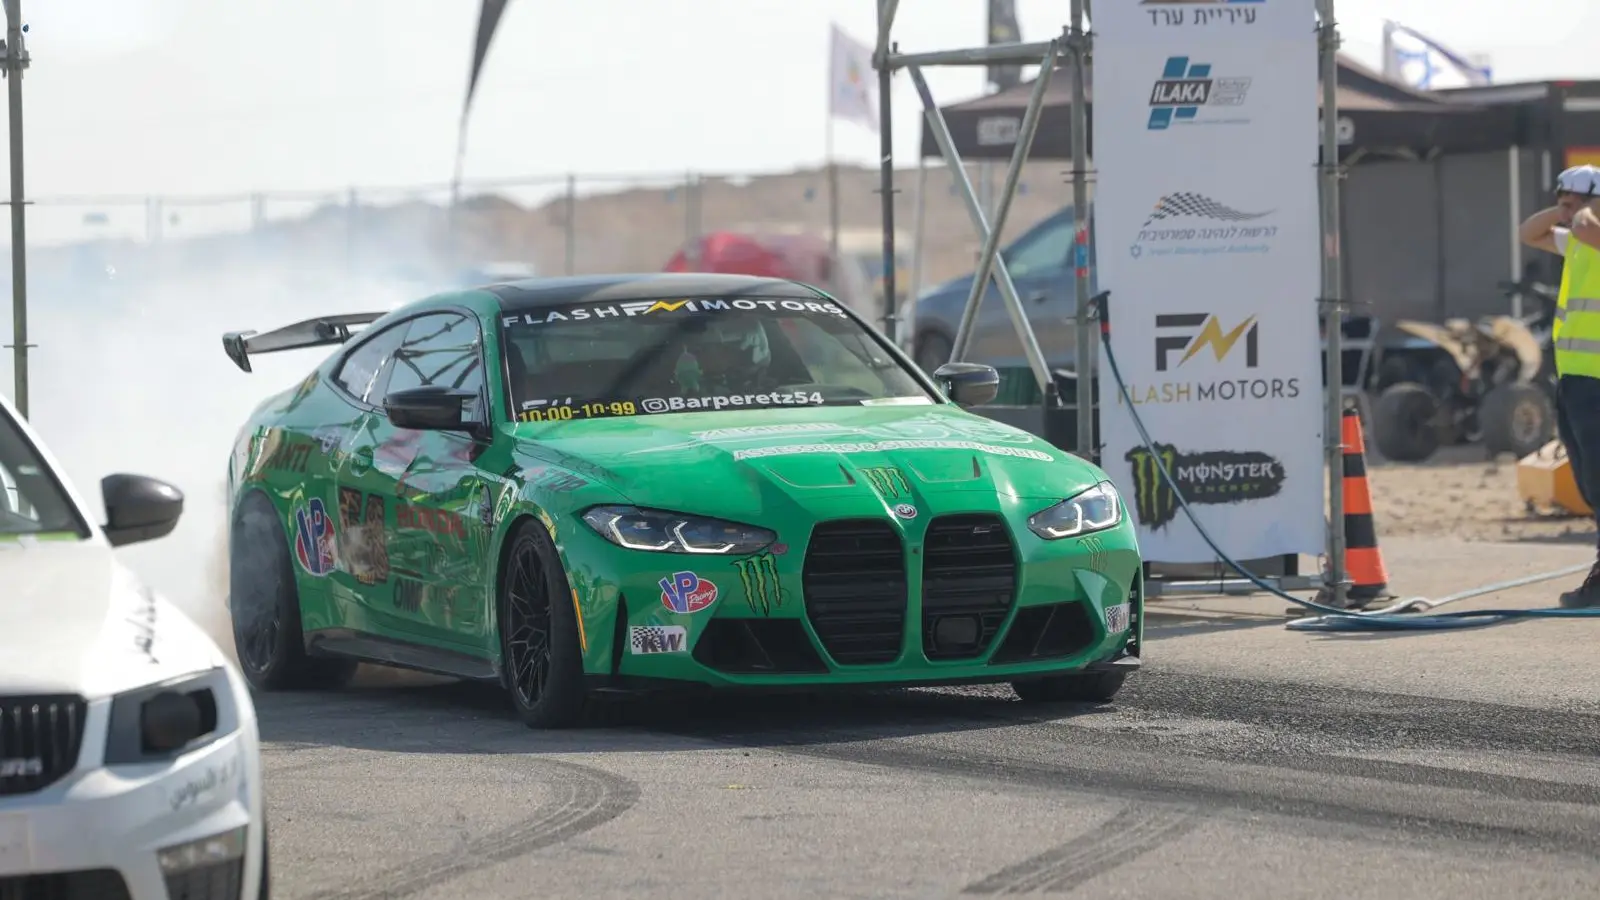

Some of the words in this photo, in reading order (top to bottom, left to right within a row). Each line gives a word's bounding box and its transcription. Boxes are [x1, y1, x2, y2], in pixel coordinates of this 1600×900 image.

[1146, 8, 1184, 26] ערד
[1193, 7, 1256, 26] עיריית
[1153, 83, 1206, 102] ILAKA
[503, 305, 620, 328] FLASH
[700, 299, 845, 316] MOTORS
[669, 391, 825, 411] Barperetz54
[1117, 381, 1191, 404] FLASH
[1197, 378, 1300, 401] MOTORS
[1194, 483, 1260, 494] ENERGY
[658, 570, 700, 614] VP
[688, 588, 716, 607] Racing
[641, 633, 683, 653] KW
